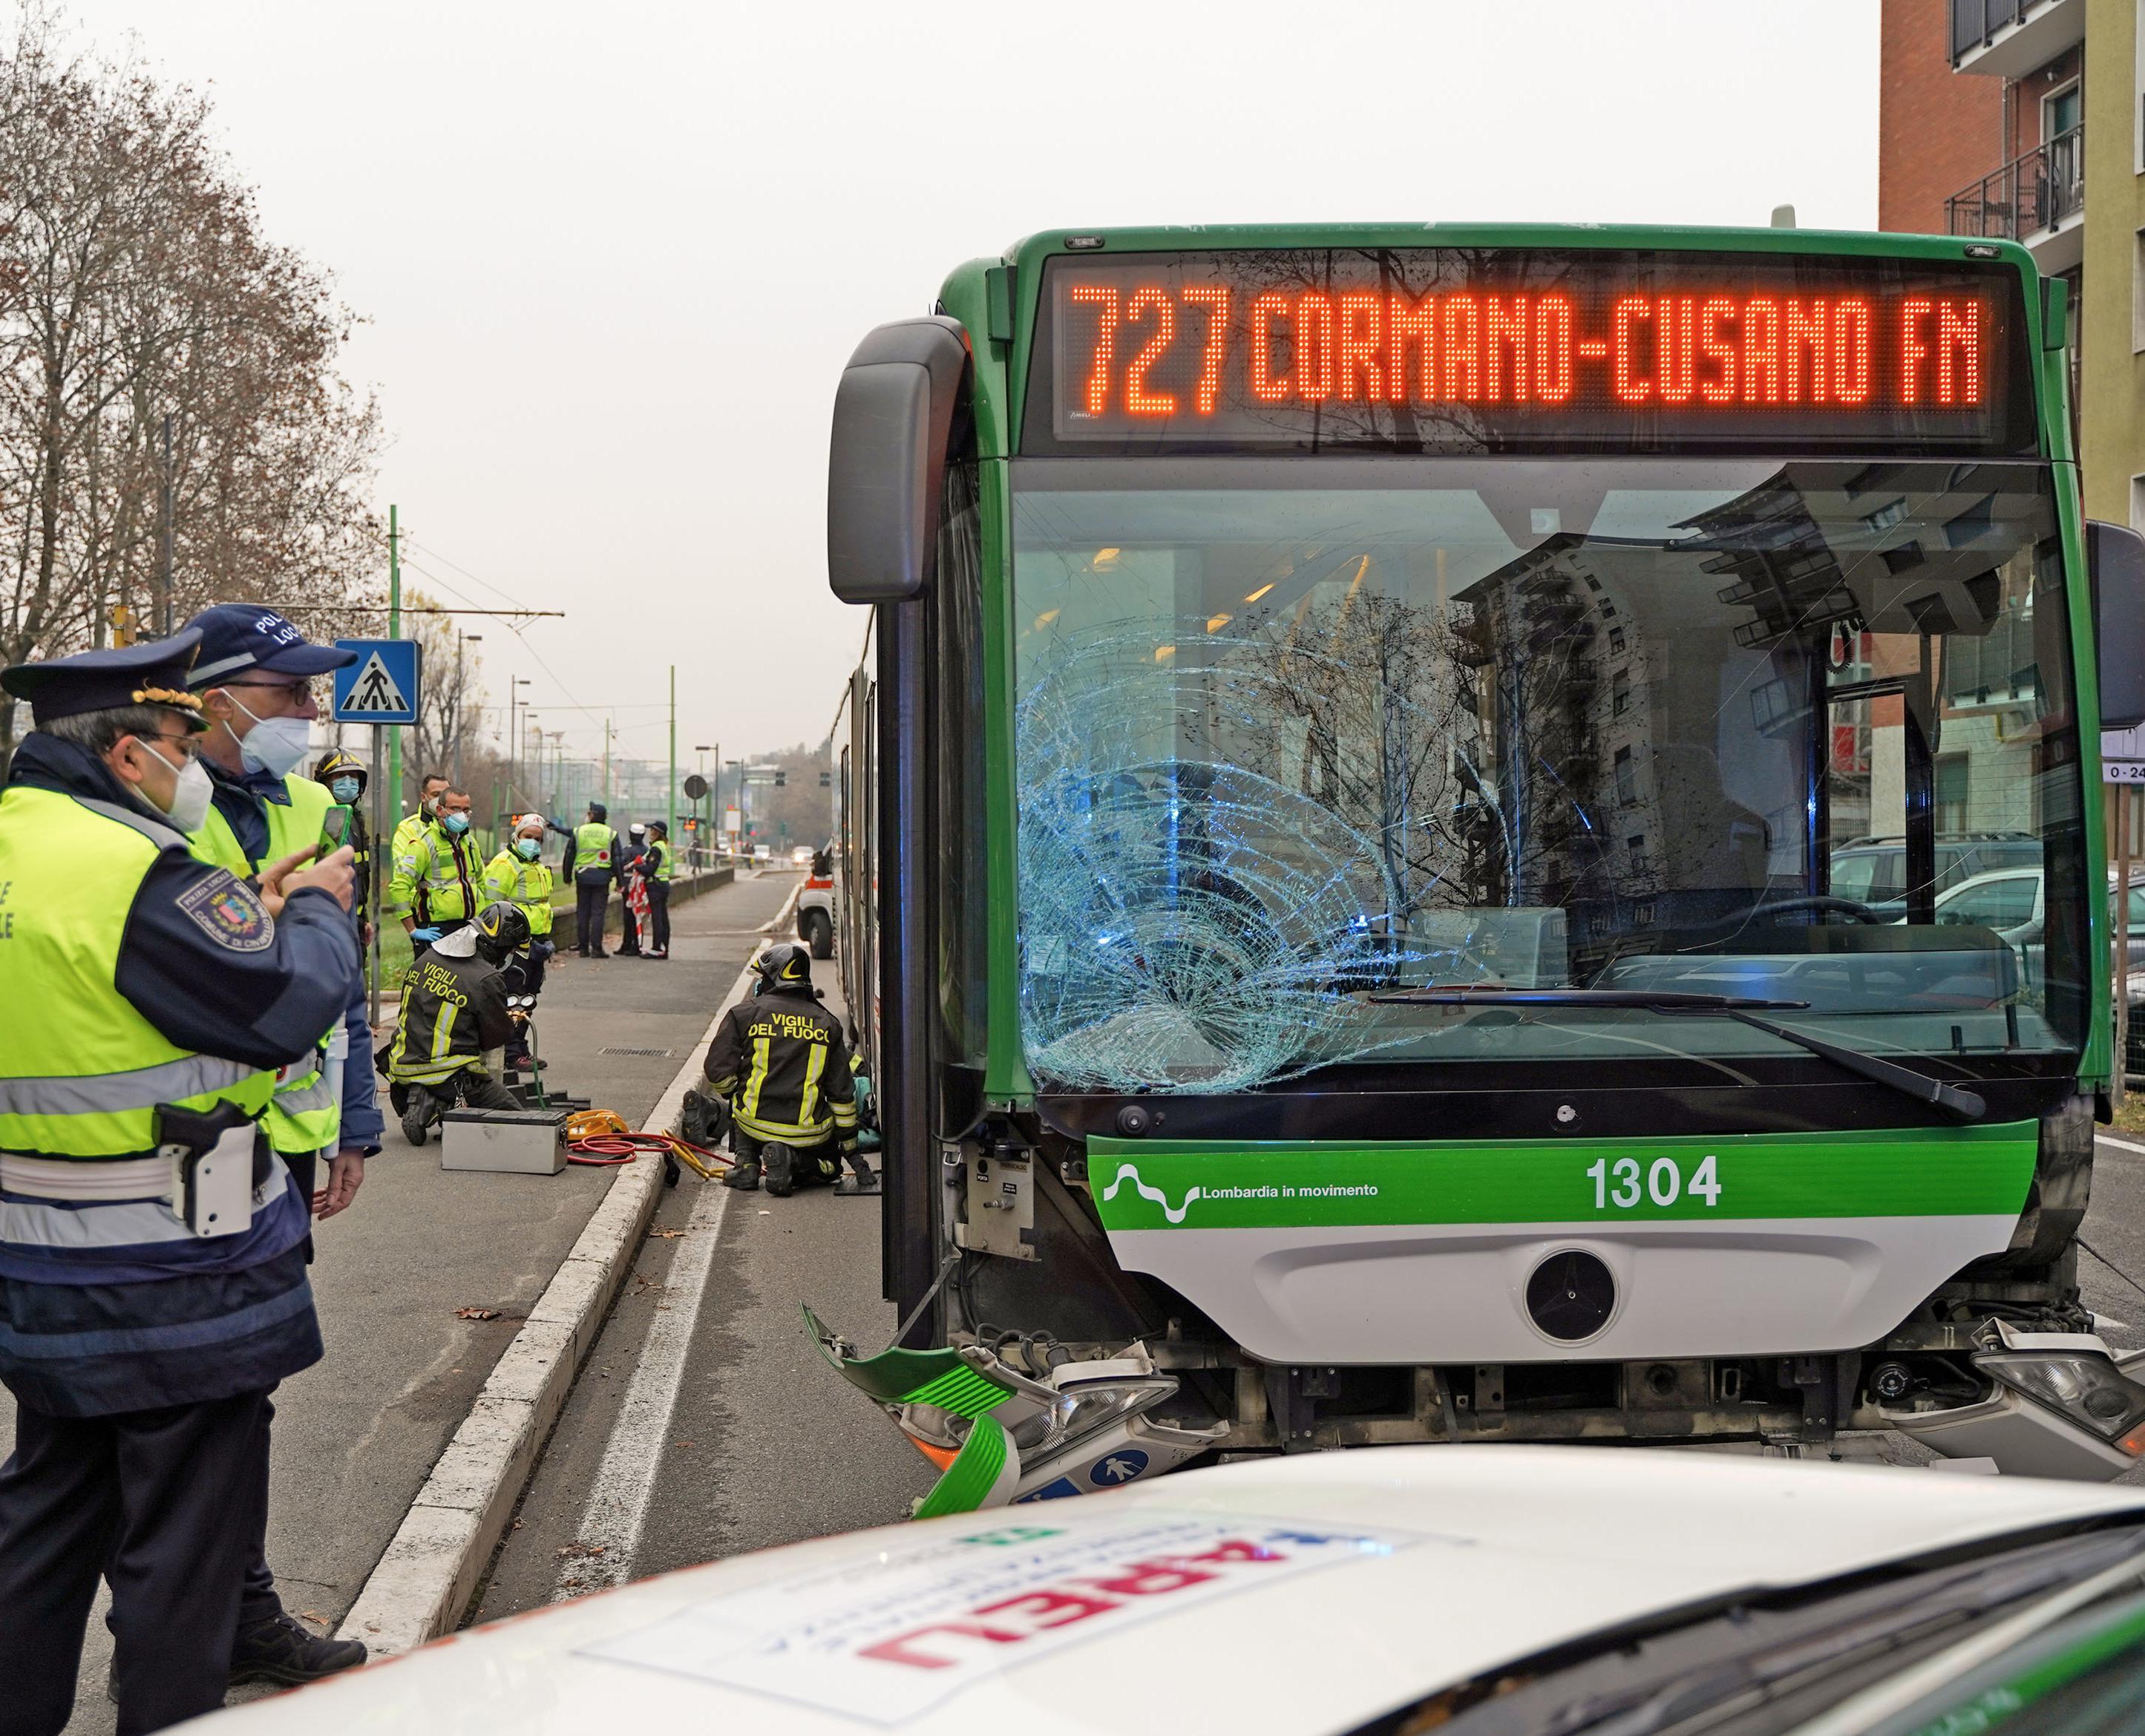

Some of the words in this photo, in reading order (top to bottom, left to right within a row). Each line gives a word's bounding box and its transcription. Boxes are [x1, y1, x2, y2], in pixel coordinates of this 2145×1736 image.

[1072, 286, 1229, 413] 727
[1253, 295, 1868, 402] CORMANO-CUSANO
[1901, 300, 1979, 403] FN
[2111, 767, 2120, 778] 0
[2130, 767, 2145, 778] 24
[423, 961, 458, 986] VIGILI
[422, 977, 468, 1008] FUOCO
[748, 1023, 777, 1037] DEL
[771, 1012, 813, 1029] VIGILI
[1202, 1185, 1278, 1199] Lombardia
[1282, 1185, 1295, 1197] in
[1299, 1184, 1378, 1197] movimento
[1586, 1155, 1722, 1209] 1304
